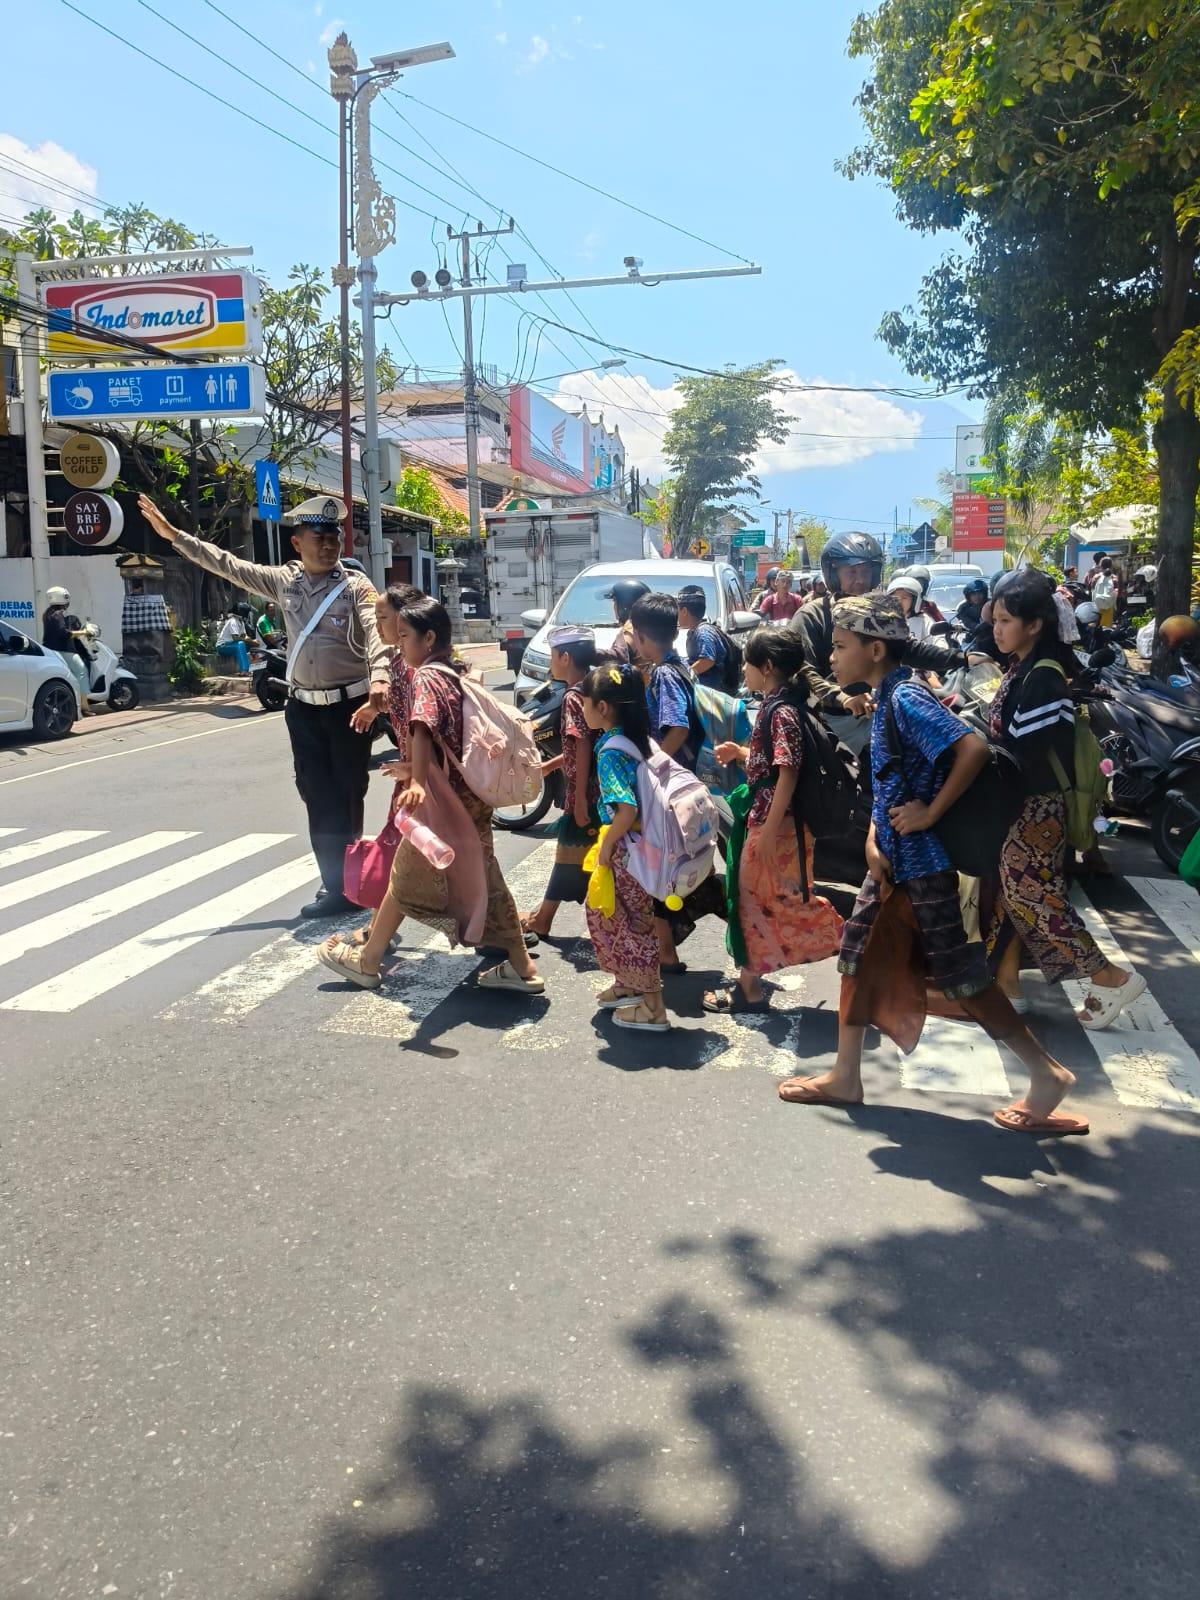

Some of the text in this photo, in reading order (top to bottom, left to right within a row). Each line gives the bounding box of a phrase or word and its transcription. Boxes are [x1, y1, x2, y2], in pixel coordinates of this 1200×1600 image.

[87, 302, 205, 329] Indomaret
[108, 377, 142, 386] PAKET
[159, 396, 192, 405] payment
[64, 456, 103, 465] COFFEE
[71, 465, 99, 474] GOLD
[75, 503, 99, 514] SAY
[76, 513, 100, 524] BRE
[77, 525, 94, 535] AD
[0, 601, 33, 610] BEBAS
[0, 610, 35, 618] PARKIR
